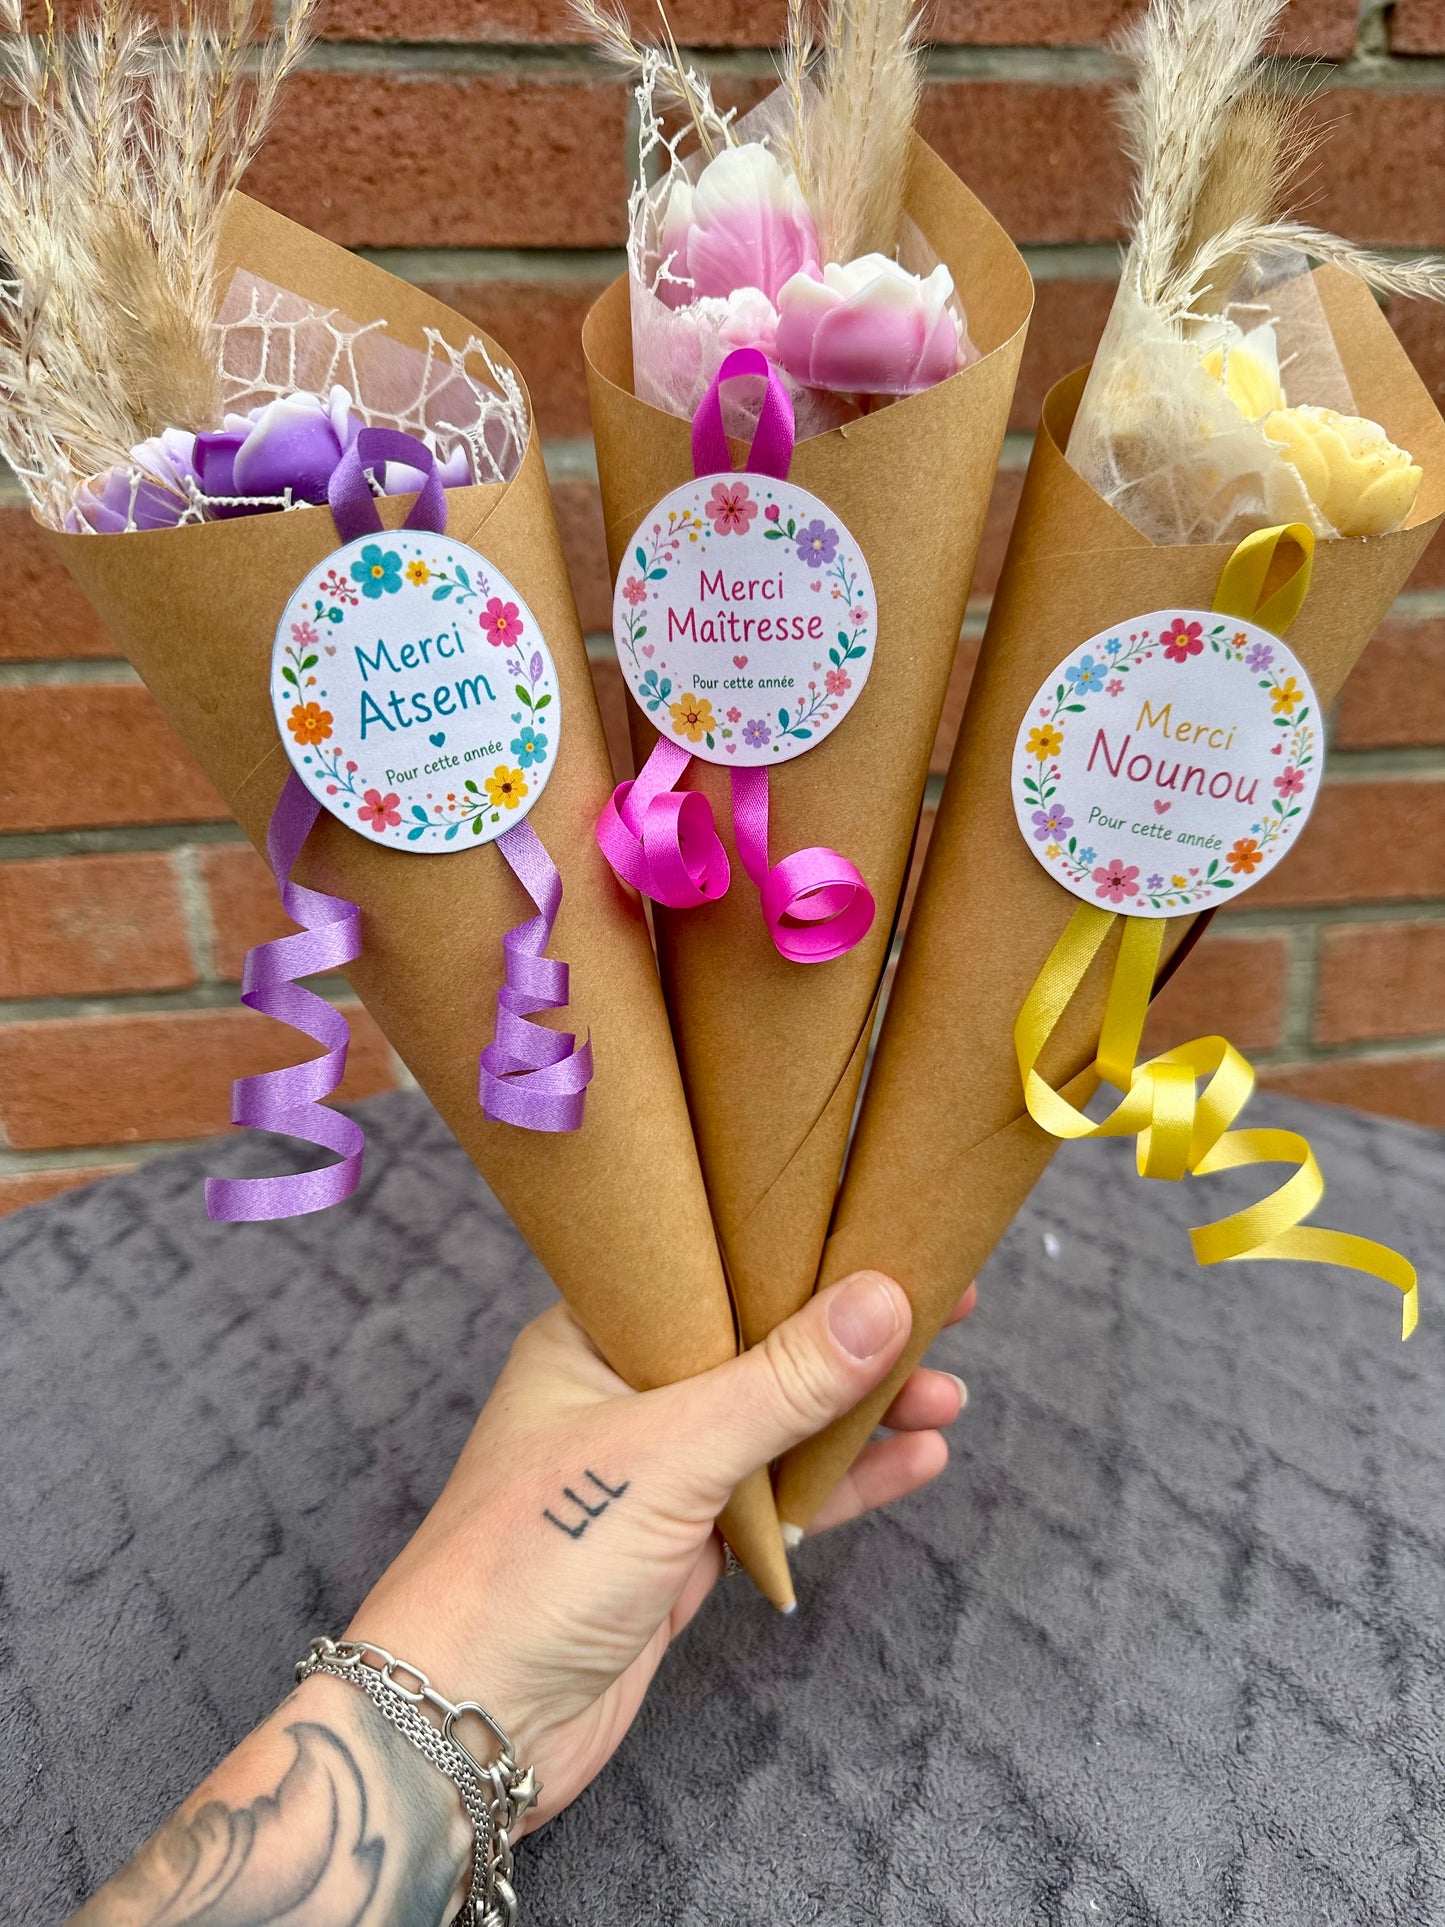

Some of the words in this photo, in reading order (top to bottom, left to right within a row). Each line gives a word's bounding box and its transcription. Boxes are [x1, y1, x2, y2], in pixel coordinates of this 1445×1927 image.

[700, 569, 784, 602] Merci
[667, 606, 824, 644] Maîtresse
[354, 622, 465, 682] Merci
[692, 674, 718, 690] Pour
[723, 676, 754, 690] cette
[758, 675, 795, 689] année
[360, 674, 497, 740] Atsem
[1136, 699, 1237, 751] Merci
[385, 768, 419, 786] Pour
[424, 752, 460, 775] cette
[463, 739, 504, 763] année
[1086, 728, 1259, 805] Nounou
[1088, 806, 1127, 831] Pour
[1131, 821, 1172, 841] cette
[1177, 830, 1223, 851] année
